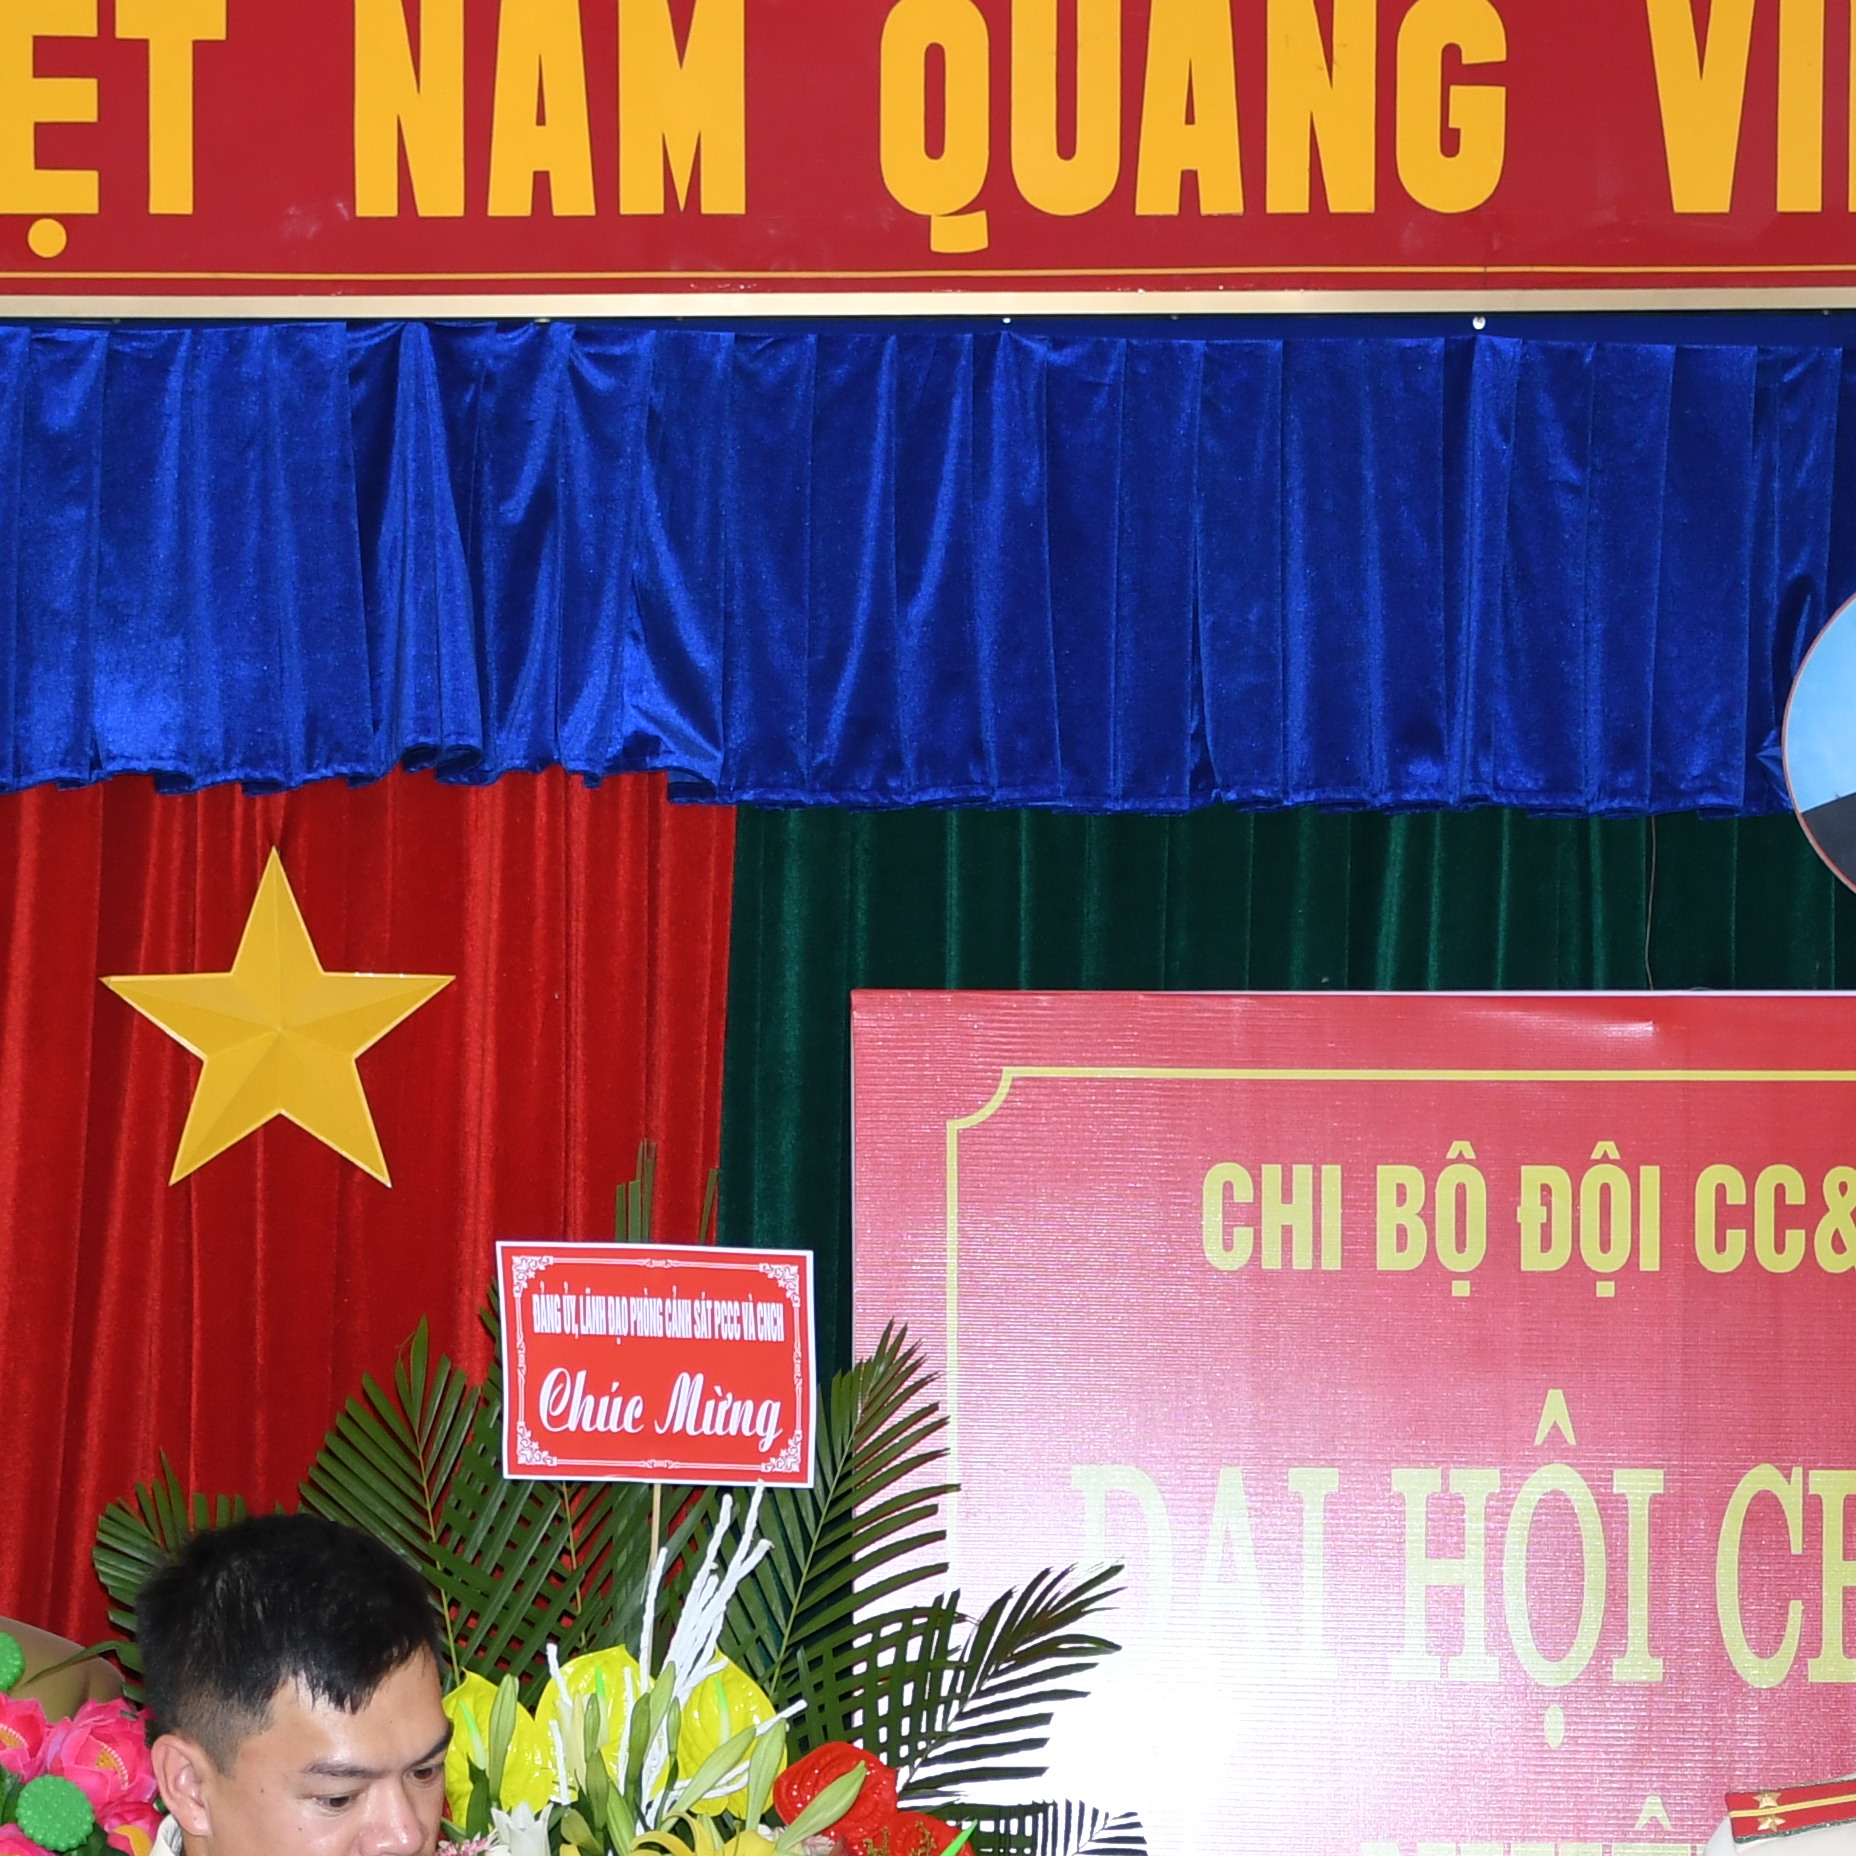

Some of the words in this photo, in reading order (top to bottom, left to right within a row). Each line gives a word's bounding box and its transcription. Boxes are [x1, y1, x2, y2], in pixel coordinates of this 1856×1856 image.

[355, 0, 747, 219] NAM
[879, 0, 1507, 255] QUANG
[1201, 1161, 1342, 1272] CHI
[1375, 1140, 1487, 1298] BỘ
[1517, 1140, 1660, 1298] ĐỘI
[532, 1280, 562, 1334] ĐẢNG
[607, 1295, 629, 1345] ĐẠO
[629, 1287, 664, 1338] PHÒNG
[664, 1284, 693, 1339] CẢNH
[693, 1290, 713, 1340] SÁT
[713, 1299, 741, 1341] PCCC
[741, 1292, 757, 1341] VÀ
[756, 1301, 785, 1343] CNCH
[538, 1367, 645, 1434] Chúc
[653, 1371, 784, 1453] Mừng
[1390, 1388, 1665, 1749] HỘI
